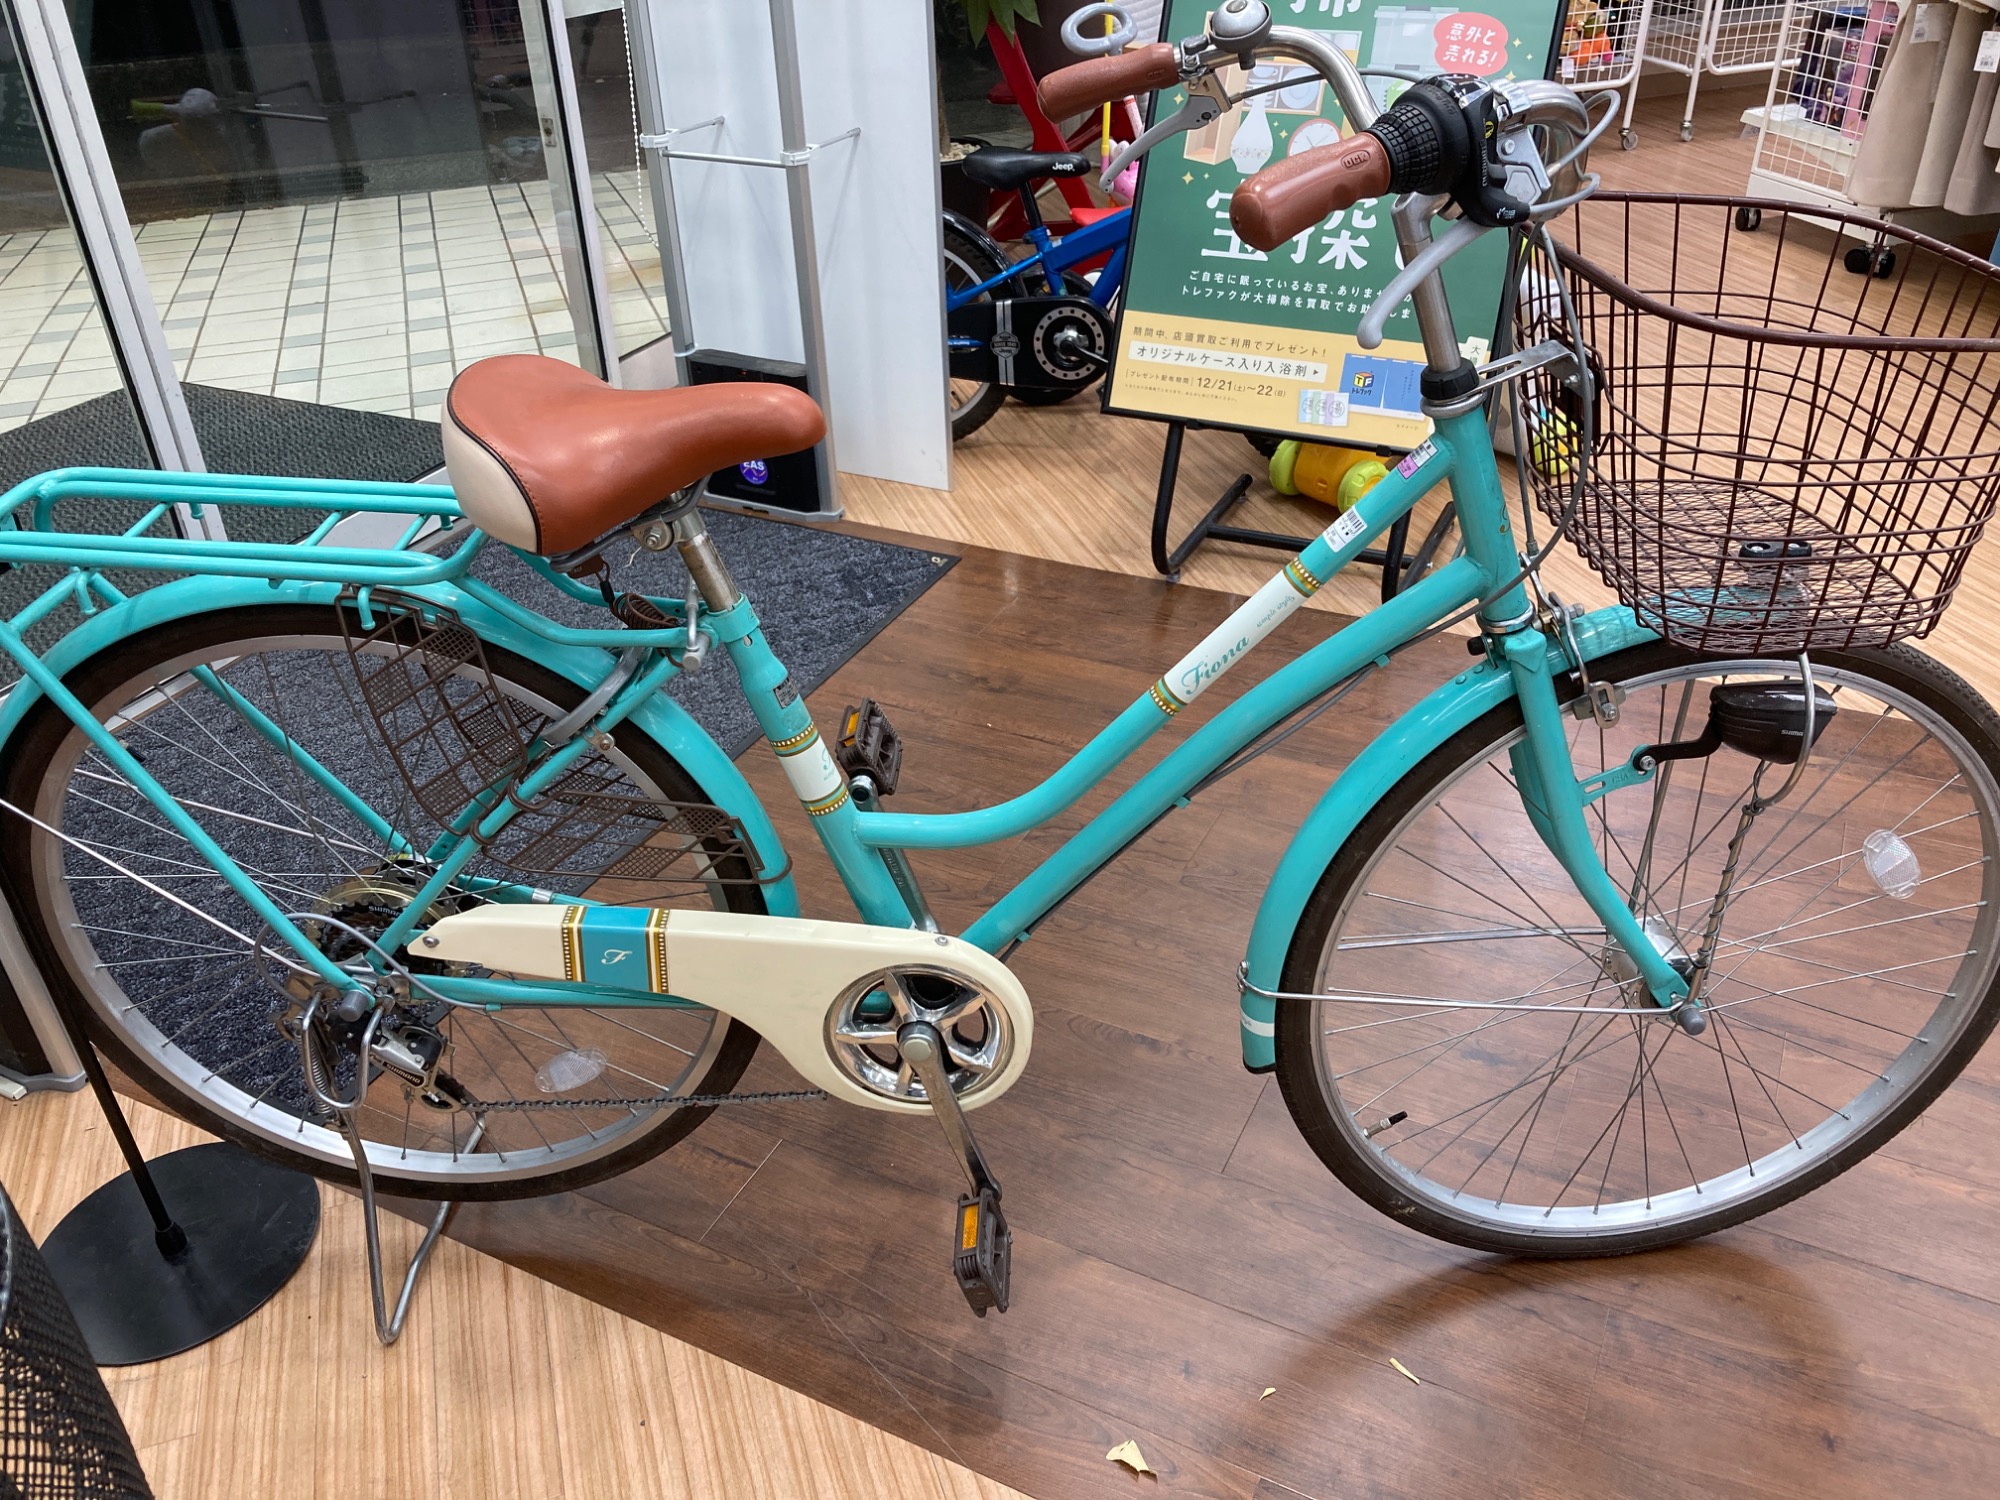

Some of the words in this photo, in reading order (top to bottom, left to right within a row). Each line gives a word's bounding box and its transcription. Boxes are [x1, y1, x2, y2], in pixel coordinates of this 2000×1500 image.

[1446, 22, 1496, 46] 意外と
[1052, 161, 1074, 171] Jeep
[1137, 345, 1307, 377] オリジナルケース入り入浴剤
[1351, 387, 1372, 396] トレファク
[1181, 637, 1250, 695] Fiona
[386, 1063, 421, 1084] SHIMANO
